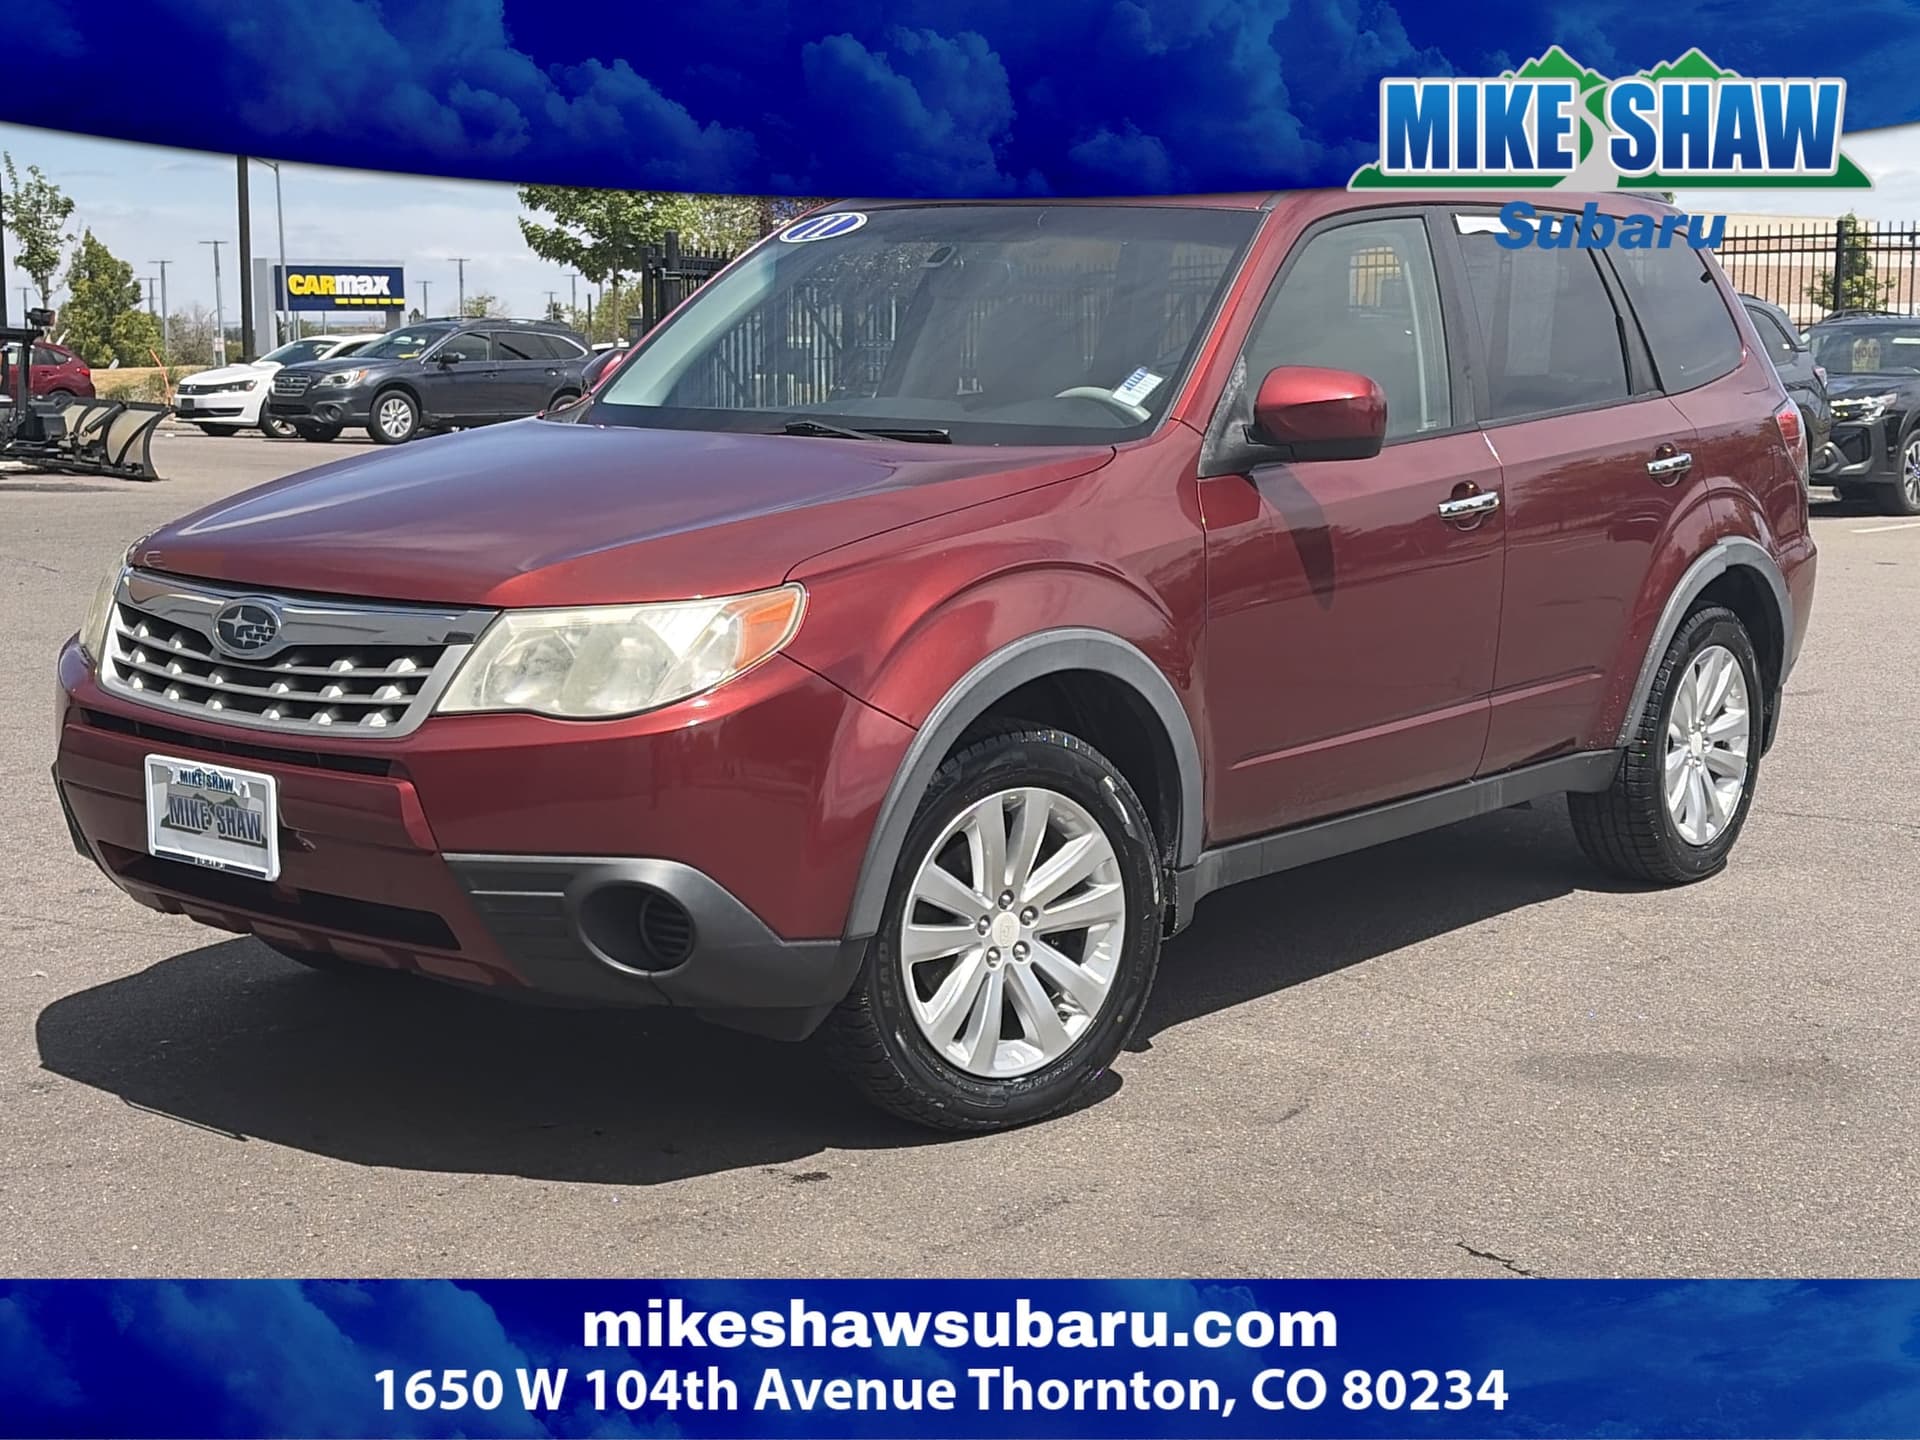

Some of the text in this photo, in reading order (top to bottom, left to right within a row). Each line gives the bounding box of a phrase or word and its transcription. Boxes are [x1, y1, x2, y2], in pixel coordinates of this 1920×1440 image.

[180, 769, 234, 793] MIKE SHAW
[169, 796, 262, 842] MIKE SHAW
